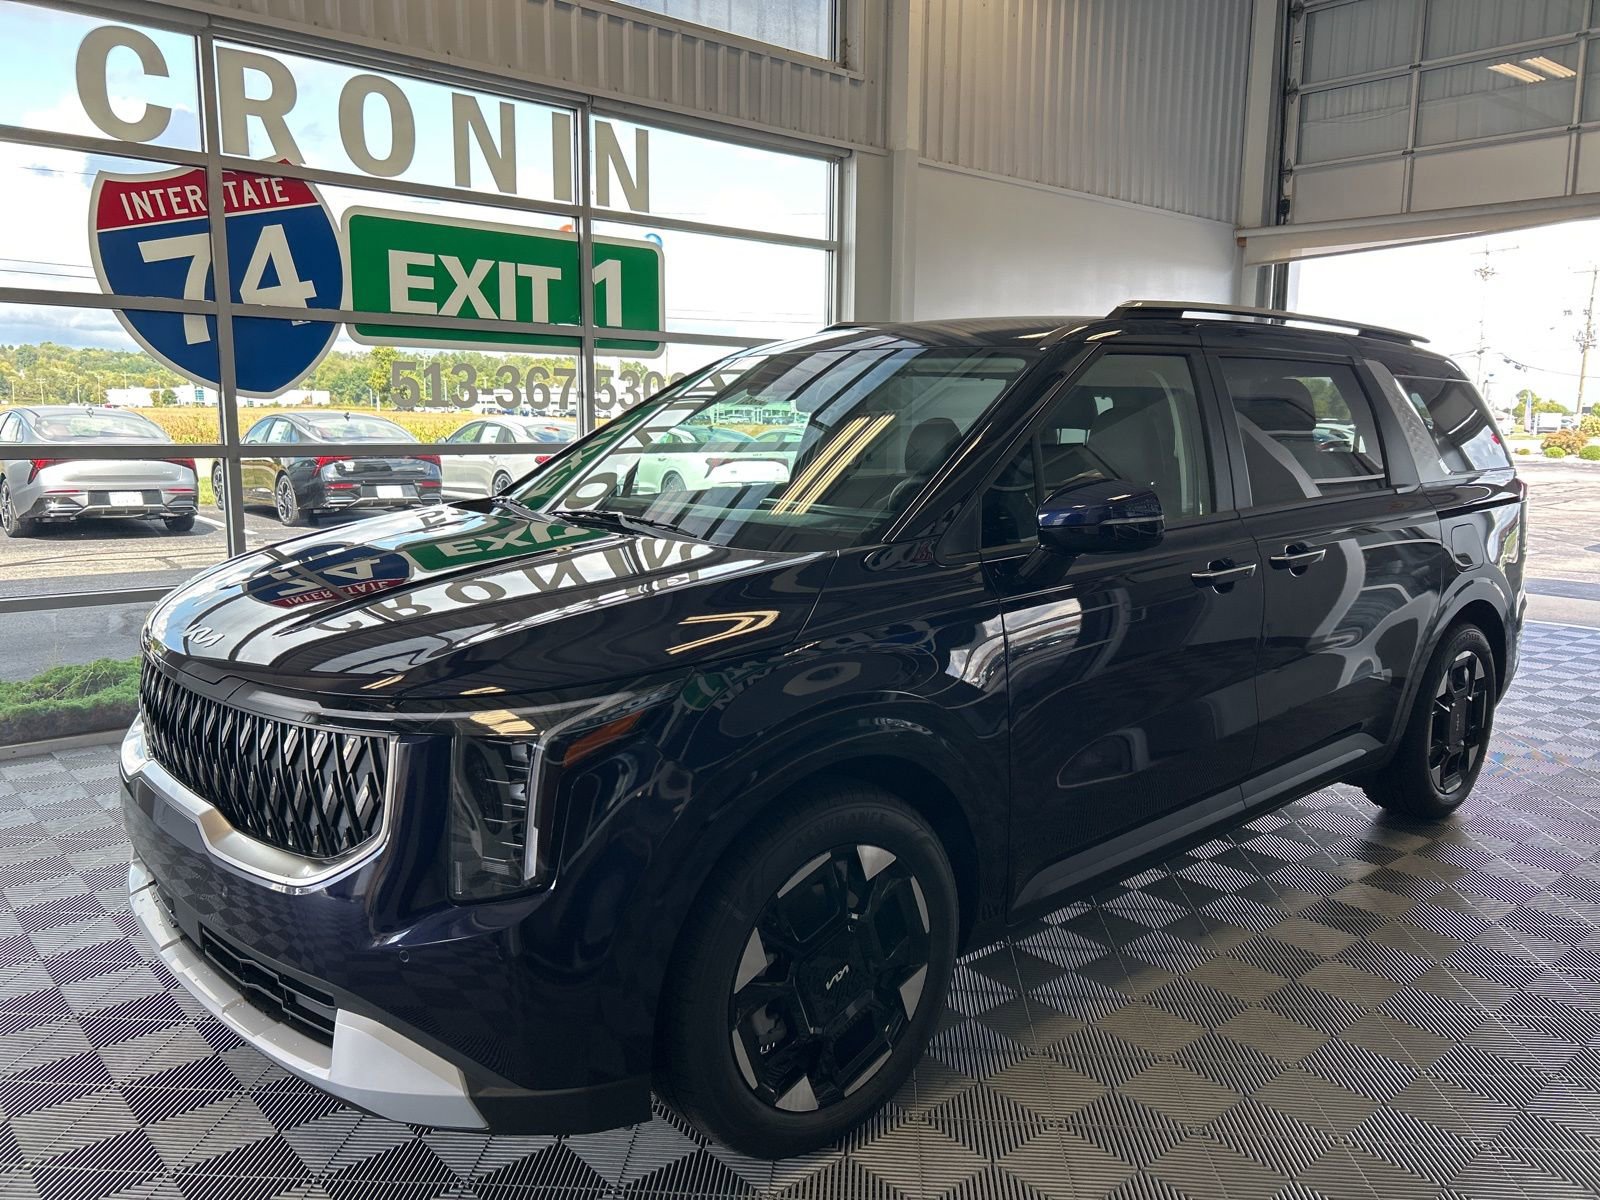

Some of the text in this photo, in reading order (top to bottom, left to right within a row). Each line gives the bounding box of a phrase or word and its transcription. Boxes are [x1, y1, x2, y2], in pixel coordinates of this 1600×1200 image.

[76, 25, 650, 214] CRONIN
[119, 176, 290, 221] INTERTATE
[137, 223, 318, 346] 74
[388, 249, 623, 328] EXIT 1
